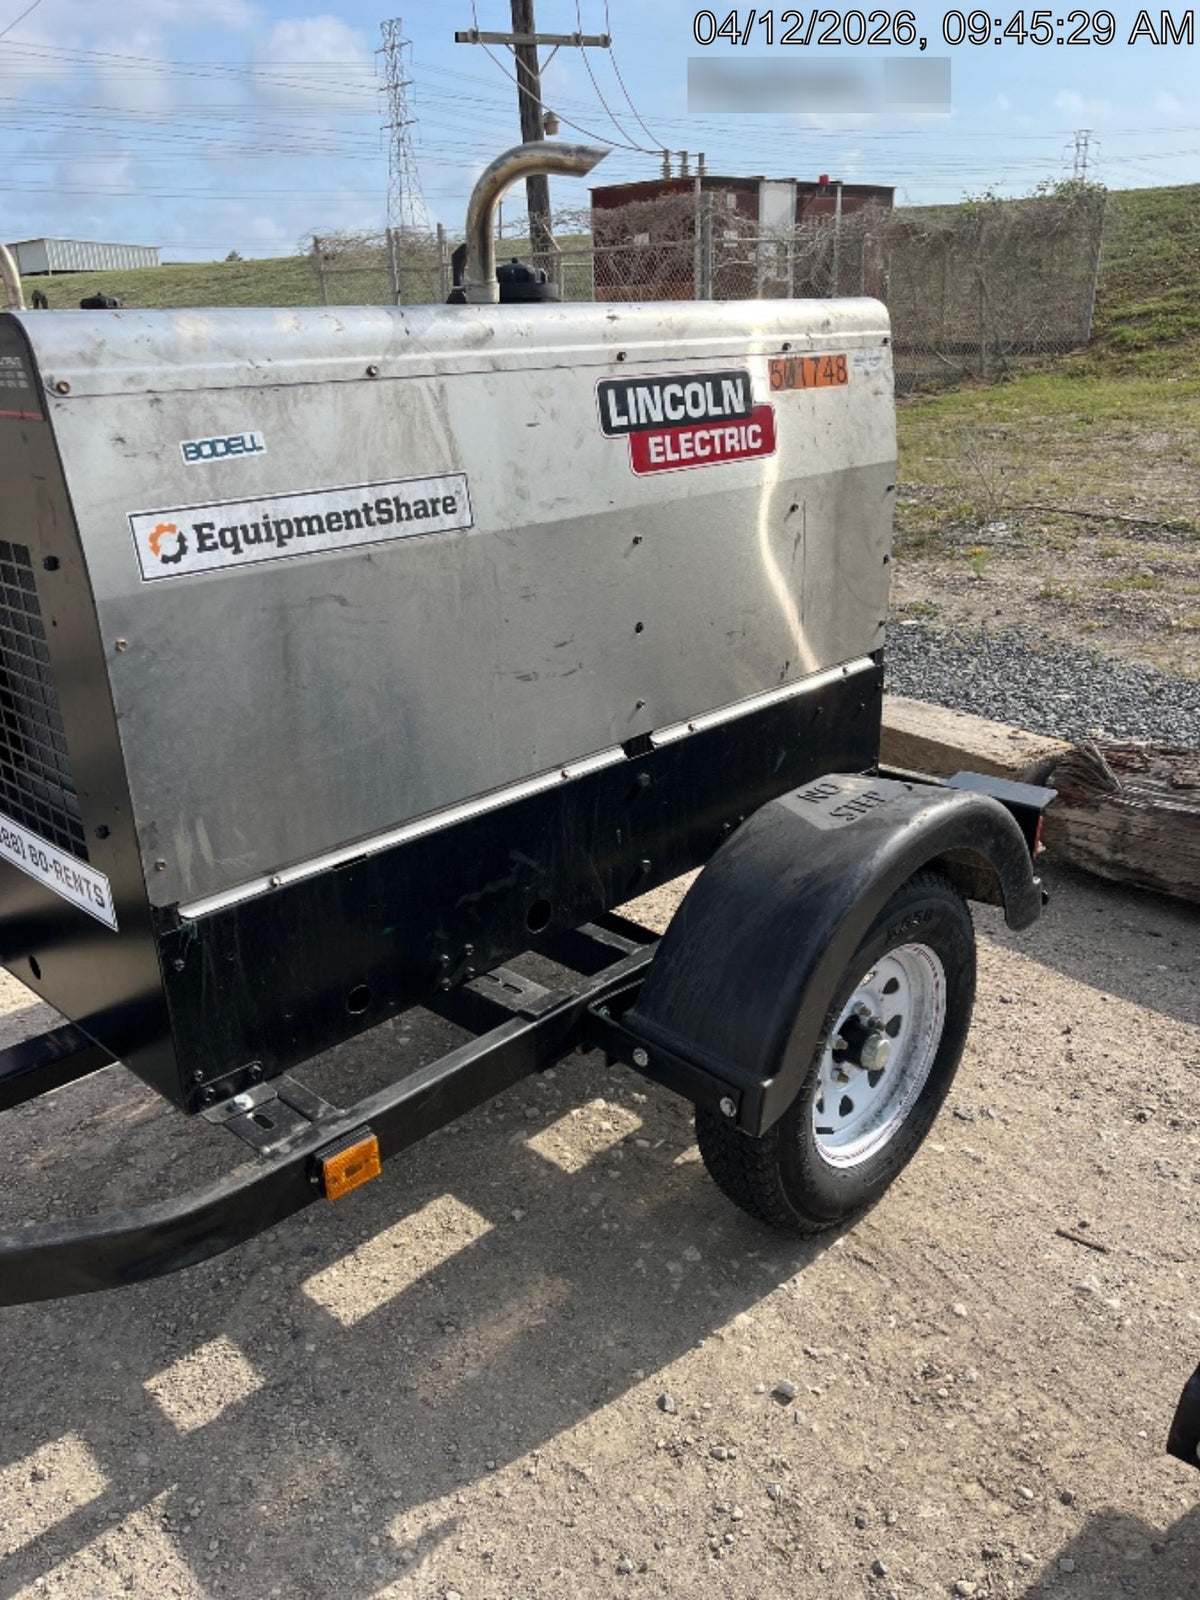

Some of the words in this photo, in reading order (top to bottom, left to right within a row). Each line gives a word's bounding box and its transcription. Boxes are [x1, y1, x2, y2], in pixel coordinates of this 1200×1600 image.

[607, 378, 745, 427] LINCOLN
[182, 434, 264, 461] BODELL
[648, 424, 762, 463] ELECTRIC
[192, 495, 458, 554] EquipmentShare
[796, 783, 839, 804] NO
[0, 826, 27, 860] 88)
